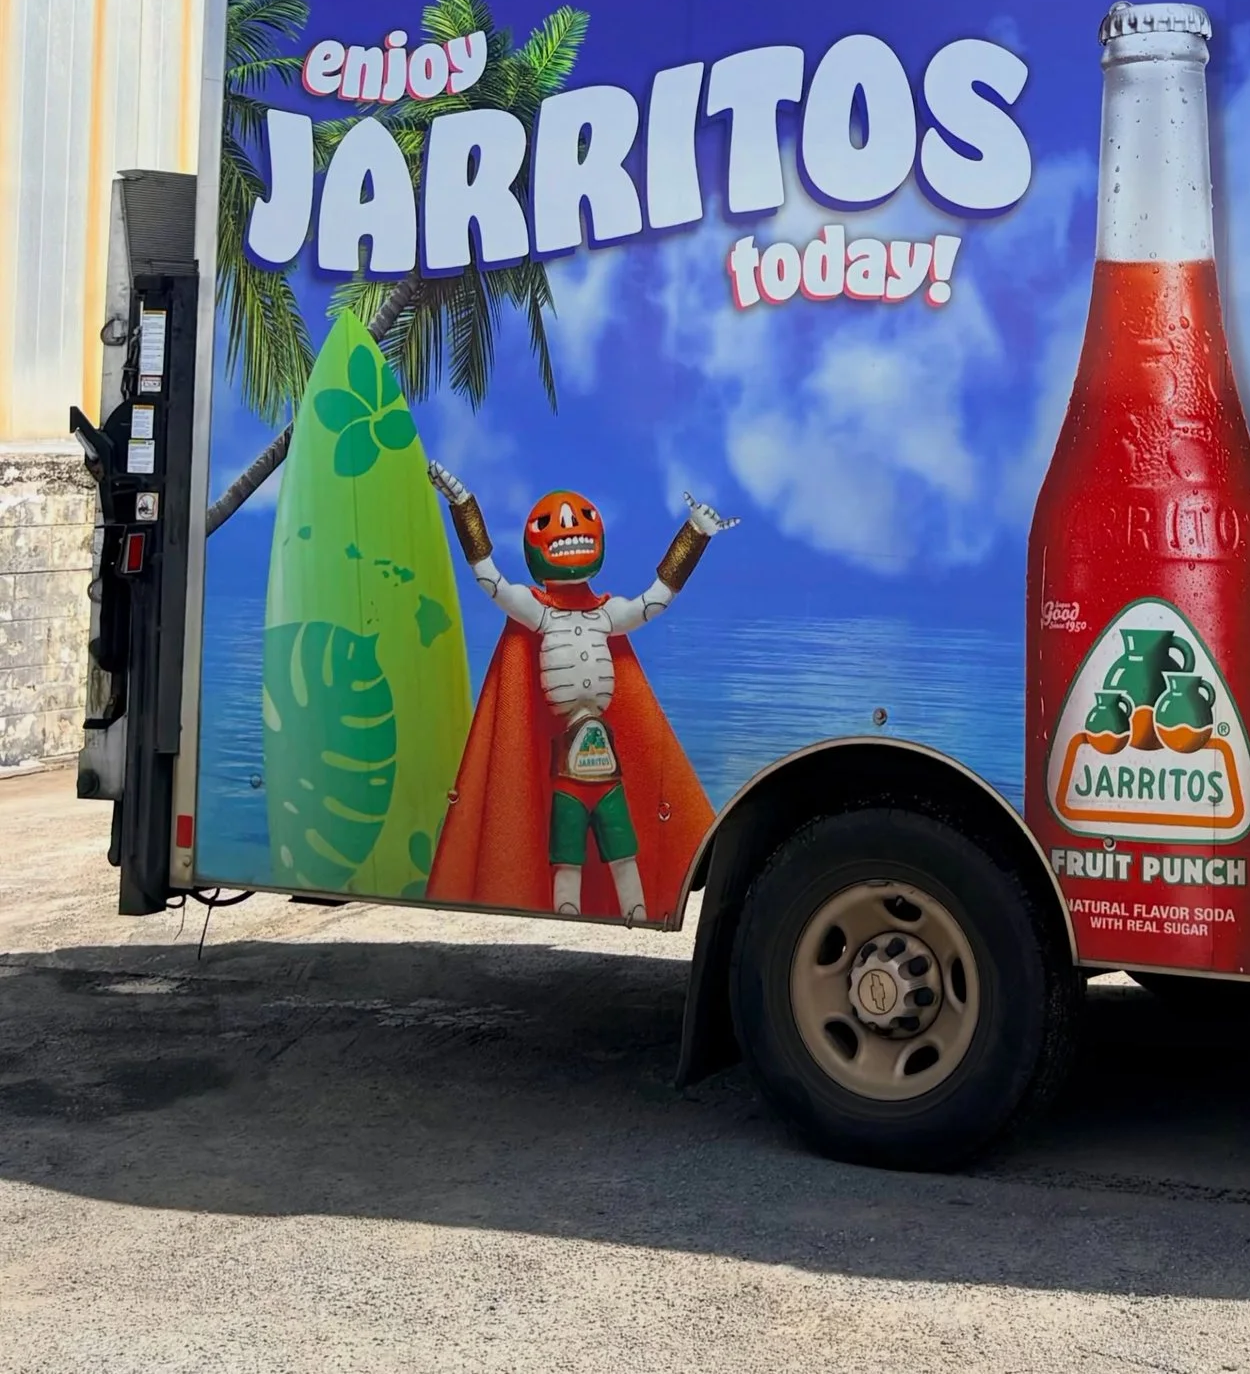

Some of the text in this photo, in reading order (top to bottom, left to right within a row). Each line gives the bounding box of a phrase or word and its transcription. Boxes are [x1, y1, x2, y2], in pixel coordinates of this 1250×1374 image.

[302, 30, 487, 104] enjoy
[246, 34, 1033, 280] JARRITOS
[727, 225, 962, 310] today!
[1066, 620, 1087, 633] 1950
[1075, 764, 1224, 803] JARRITOS
[1051, 848, 1248, 886] FRUIT PUNCH
[1090, 916, 1208, 936] WITH REAL SUGAR
[1133, 903, 1189, 920] FLAVOR
[1194, 907, 1235, 923] SODA
